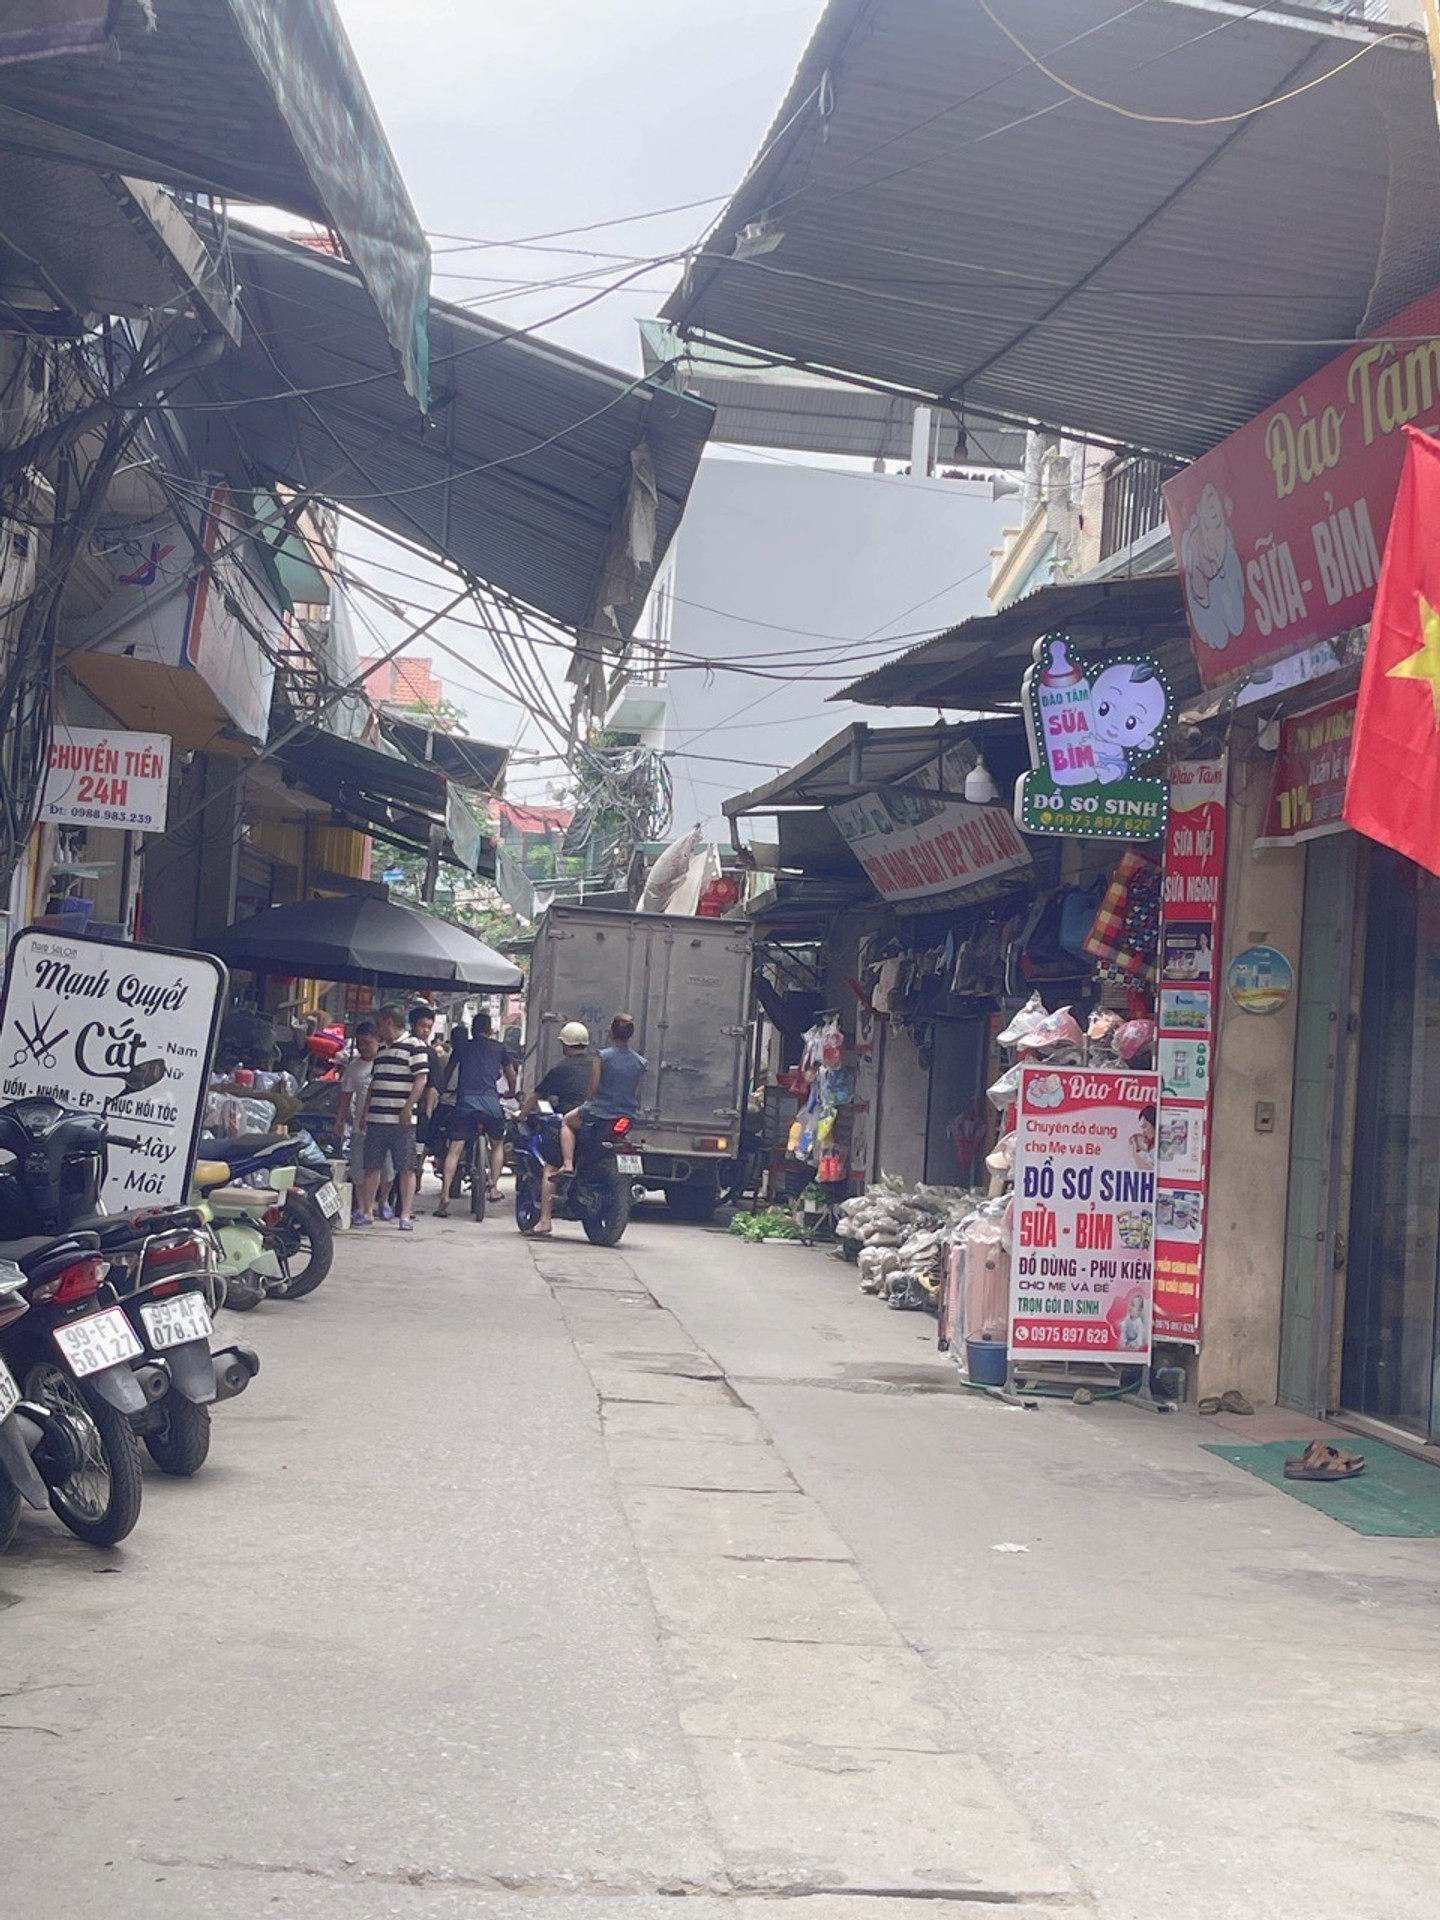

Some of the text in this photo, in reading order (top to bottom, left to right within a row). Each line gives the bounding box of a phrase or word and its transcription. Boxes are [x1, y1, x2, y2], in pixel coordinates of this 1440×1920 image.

[1265, 338, 1440, 499] Đào Tâm
[1312, 490, 1381, 606] BỈM
[1048, 709, 1090, 736] SỮA
[47, 738, 163, 779] CHUYỂN TIỀN
[1052, 742, 1095, 771] BỈM
[77, 776, 128, 806] 24H
[1033, 787, 1158, 817] ĐỒ SƠ SINH
[35, 958, 189, 1016] Mạnh Quyết
[75, 1017, 148, 1078] Cắt
[166, 1042, 198, 1057] Nam
[3, 1075, 27, 1097] UỐN
[79, 1089, 94, 1107] ÉP
[157, 1102, 178, 1121] TÓC
[1069, 1074, 1158, 1102] Đào Tâm
[1025, 1140, 1047, 1153] cho
[1048, 1141, 1067, 1156] Mẹ
[124, 1170, 166, 1194] Môi
[1024, 1156, 1154, 1203] ĐỒ SƠ SINH
[1020, 1202, 1057, 1248] SỮA
[1075, 1201, 1113, 1250] BỈM
[1041, 1254, 1077, 1277] DÙNG
[1090, 1259, 1117, 1283] PHỤ
[1120, 1257, 1151, 1284] KIỆN
[1018, 1281, 1045, 1290] CHO
[1049, 1282, 1066, 1292] MẸ
[1094, 1282, 1109, 1293] BÉ
[1018, 1295, 1099, 1316] TRỌN GÓI ĐI SINH
[65, 1315, 119, 1349] 99-F1
[153, 1316, 209, 1345] 078.11
[1031, 1326, 1108, 1343] 0975 897 628
[70, 1333, 134, 1372] 581.27
